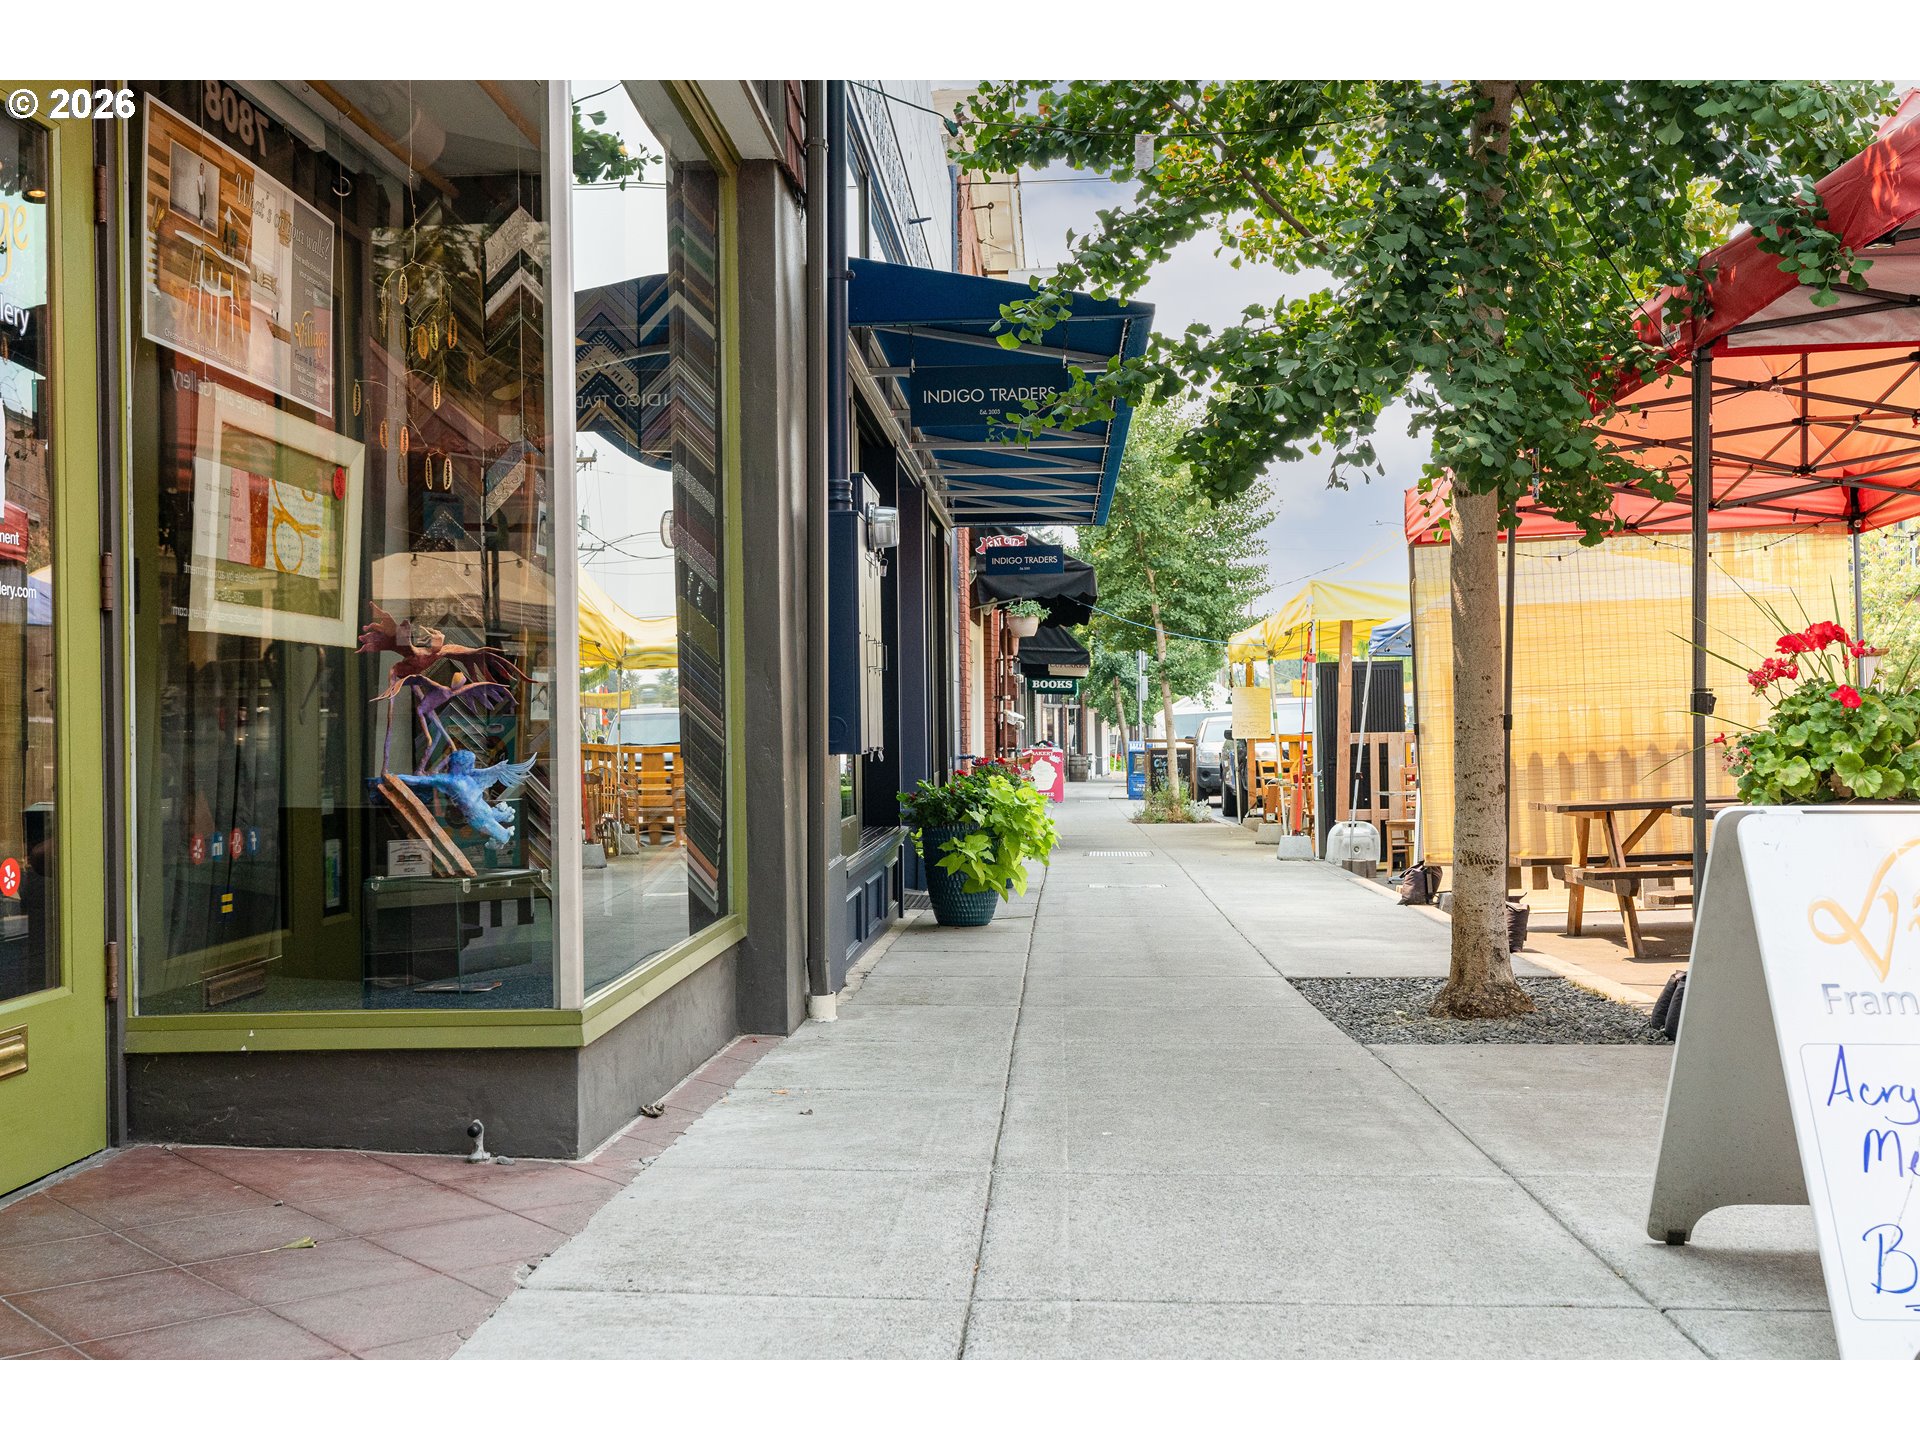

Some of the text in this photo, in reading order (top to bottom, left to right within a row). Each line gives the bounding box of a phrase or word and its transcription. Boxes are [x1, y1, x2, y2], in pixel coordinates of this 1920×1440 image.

[294, 310, 328, 358] Village
[923, 386, 1056, 404] INDIGO TRADERS
[992, 555, 1058, 565] INDIGO TRADERS
[1032, 680, 1073, 689] BOOKS
